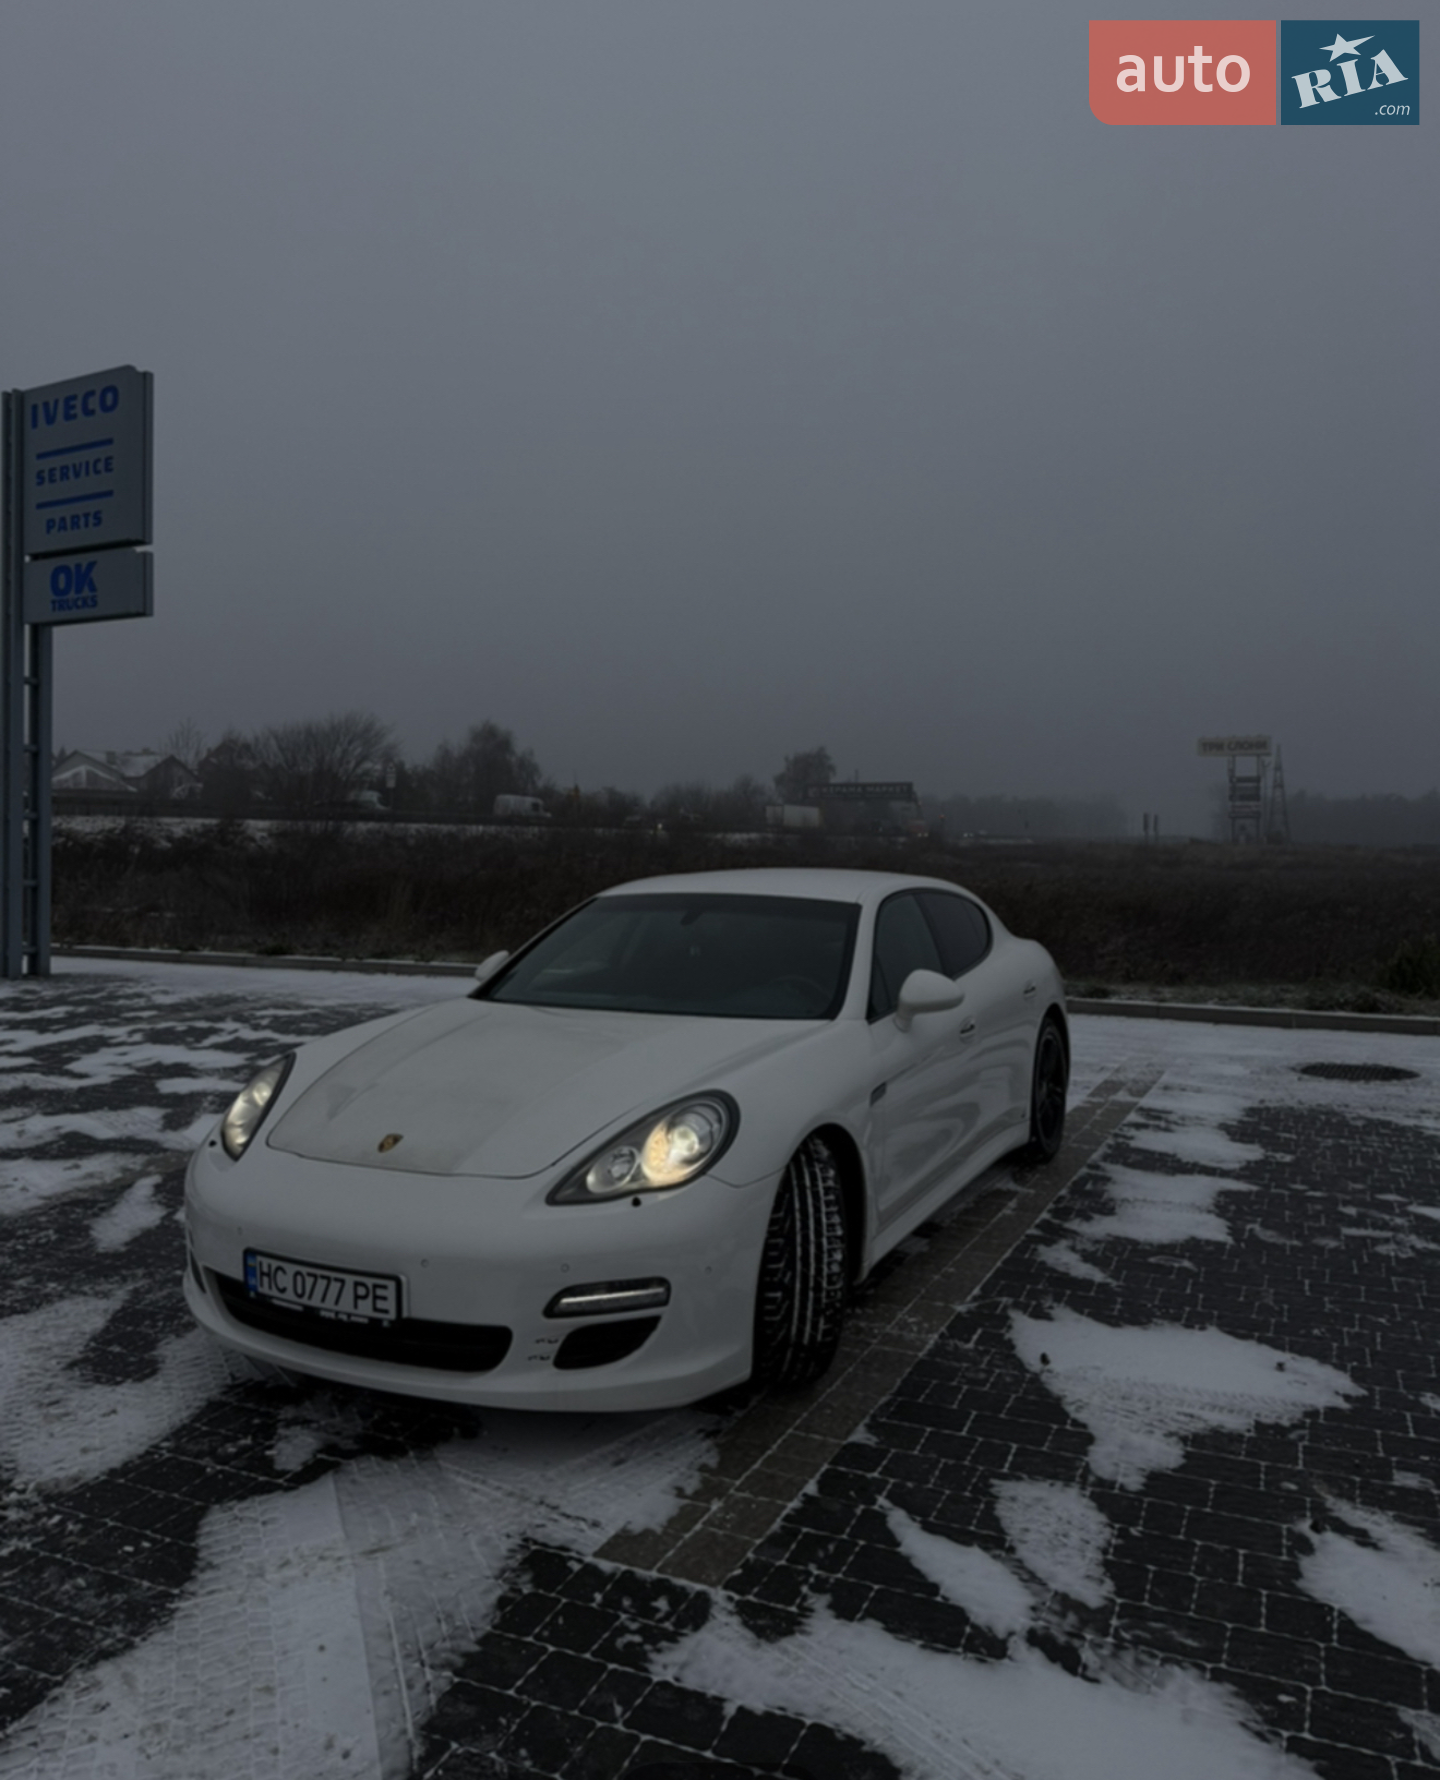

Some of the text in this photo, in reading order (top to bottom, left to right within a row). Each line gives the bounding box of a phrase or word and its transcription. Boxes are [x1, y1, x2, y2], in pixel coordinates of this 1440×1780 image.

[31, 384, 119, 430] IVECO
[36, 456, 114, 486] SERVICE
[46, 510, 102, 534] PARTS
[50, 561, 97, 597] OK
[51, 595, 98, 612] TRUCKS
[259, 1260, 389, 1314] HC 0777 PE
